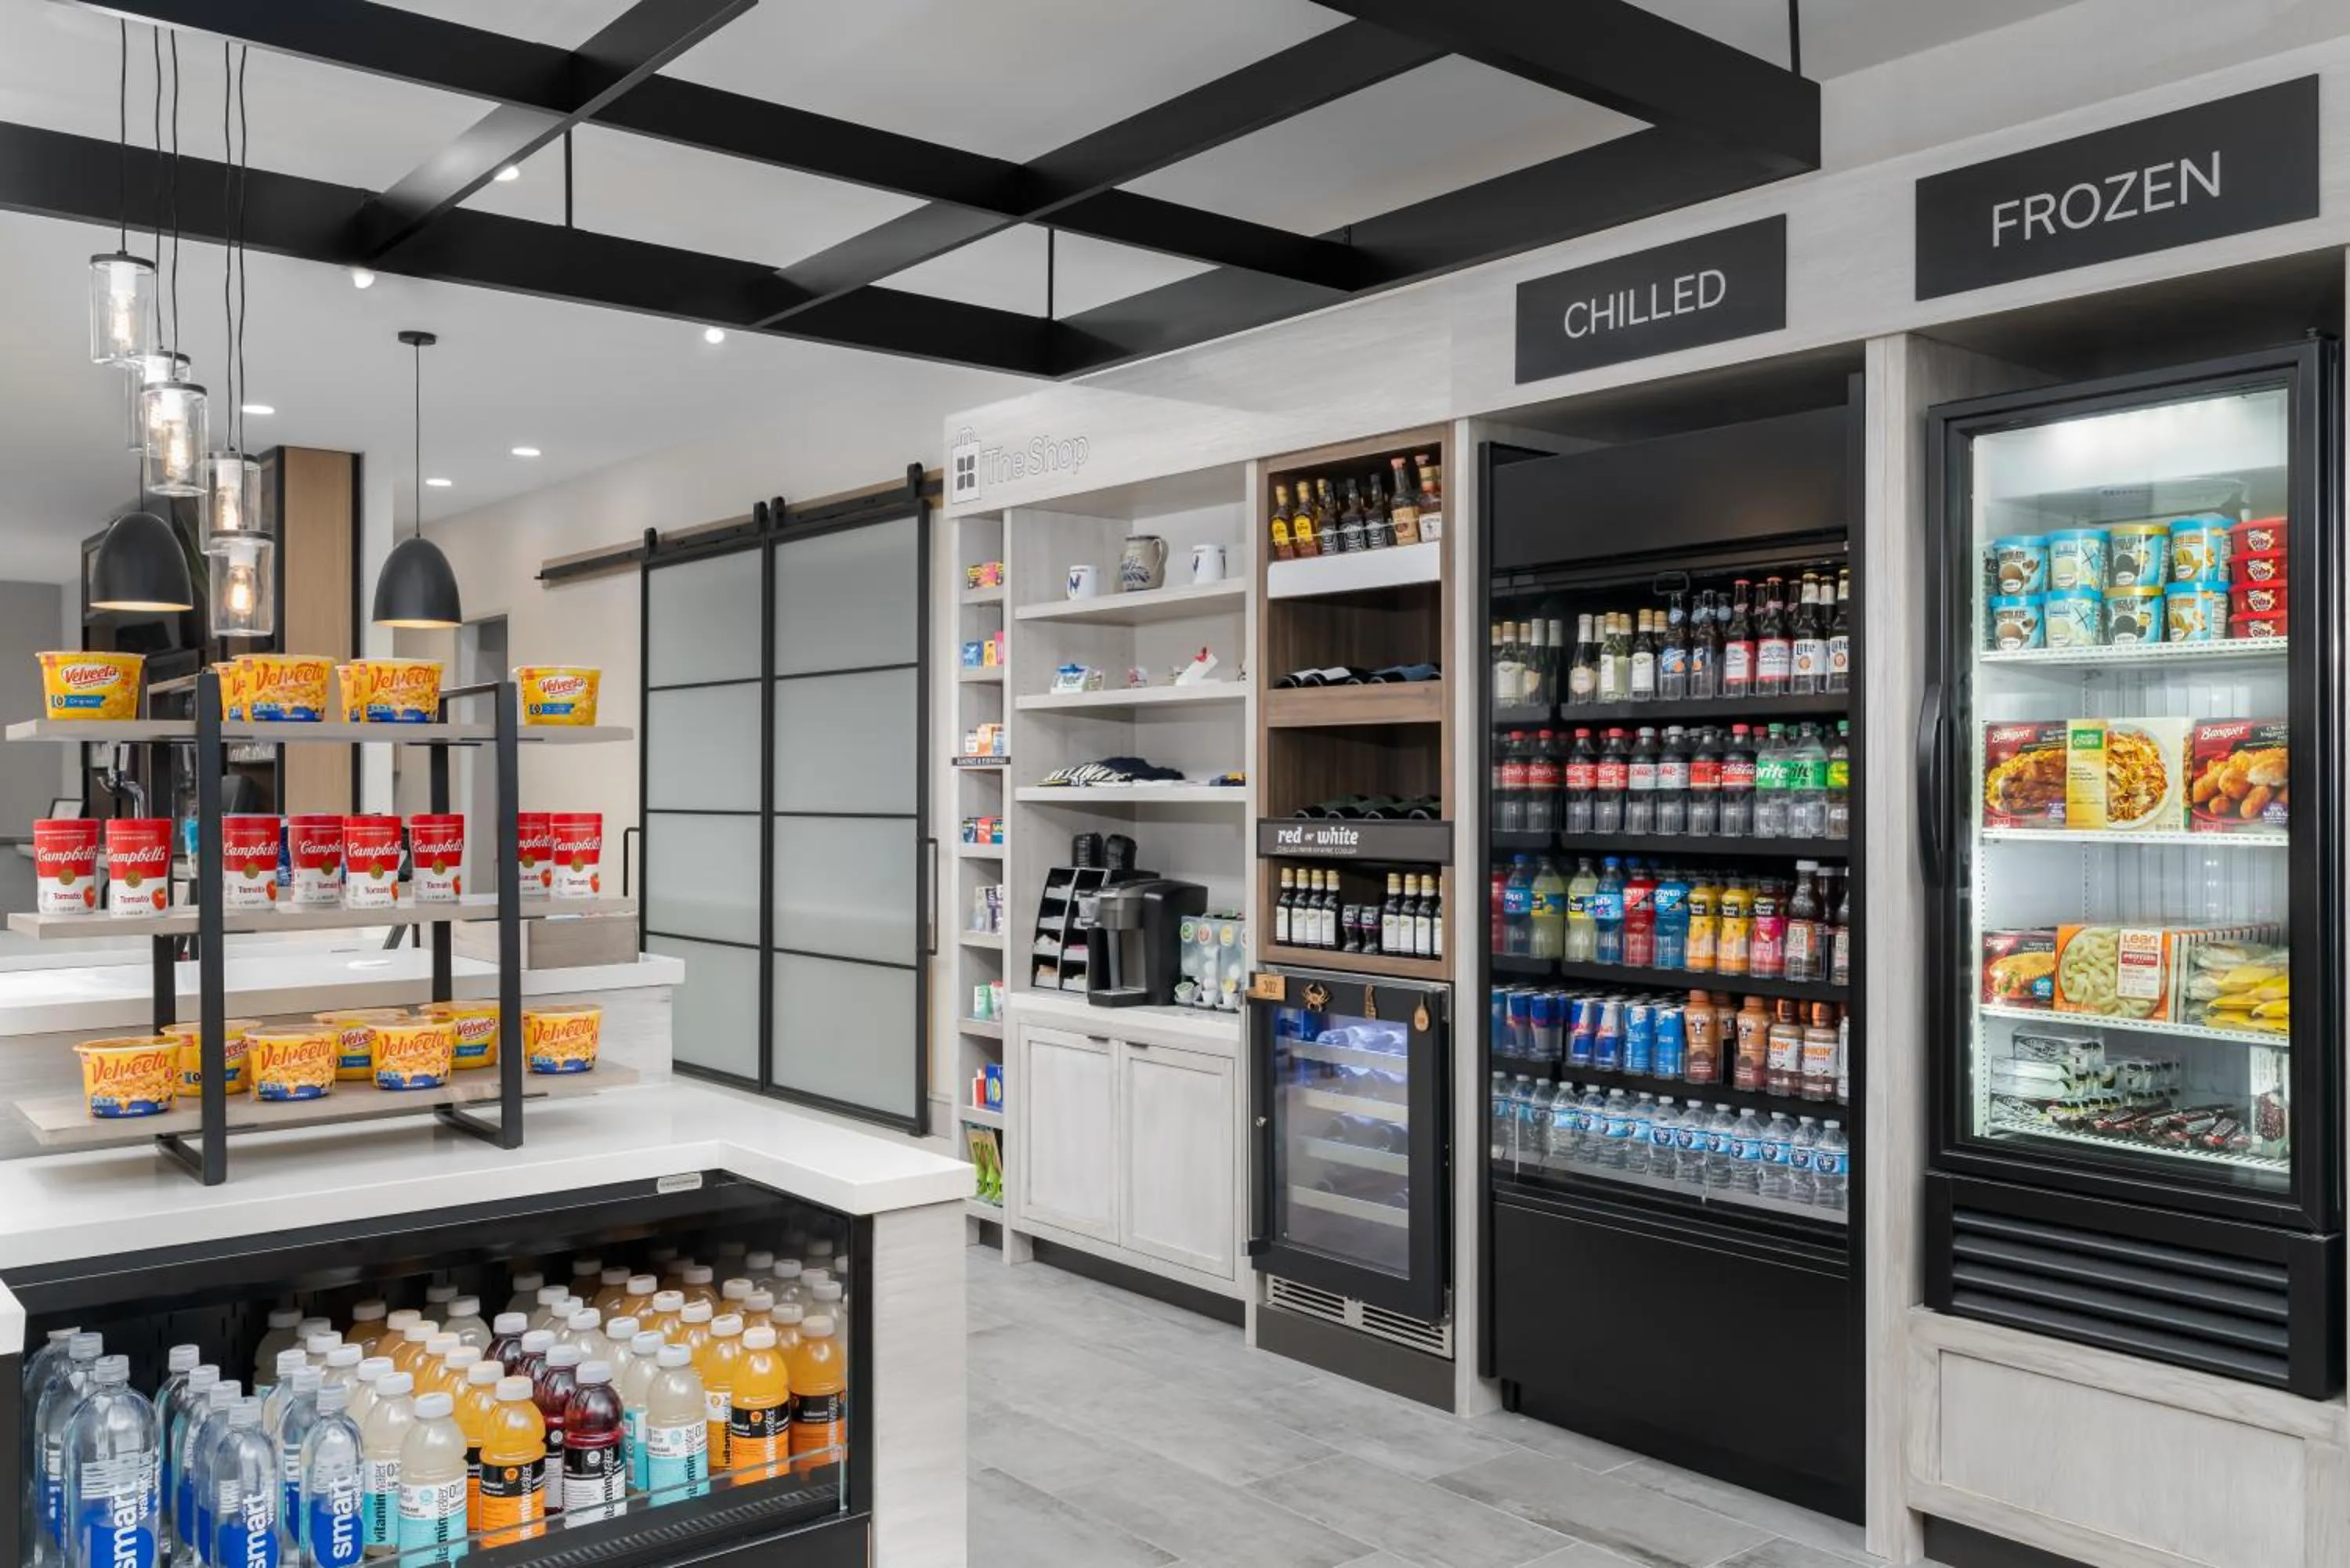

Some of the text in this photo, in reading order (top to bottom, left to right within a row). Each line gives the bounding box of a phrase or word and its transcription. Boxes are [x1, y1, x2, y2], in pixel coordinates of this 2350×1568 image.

[1992, 150, 2221, 247] FROZEN
[1564, 269, 1726, 340] CHILLED
[982, 435, 1089, 484] The Shop
[64, 666, 117, 683] Velveeta
[256, 662, 324, 691] Velveeta
[371, 666, 434, 693] Velveeta
[1757, 764, 1788, 779] rite
[1278, 826, 1302, 844] red
[1317, 826, 1358, 845] white
[107, 846, 165, 865] Campbell's
[379, 1031, 446, 1060] Velveeta
[534, 1017, 594, 1045] Velveeta
[94, 1051, 167, 1083] Velveeta
[262, 1039, 331, 1071] Velveeta
[329, 1476, 352, 1559] smart
[435, 1486, 449, 1563] itaminwater
